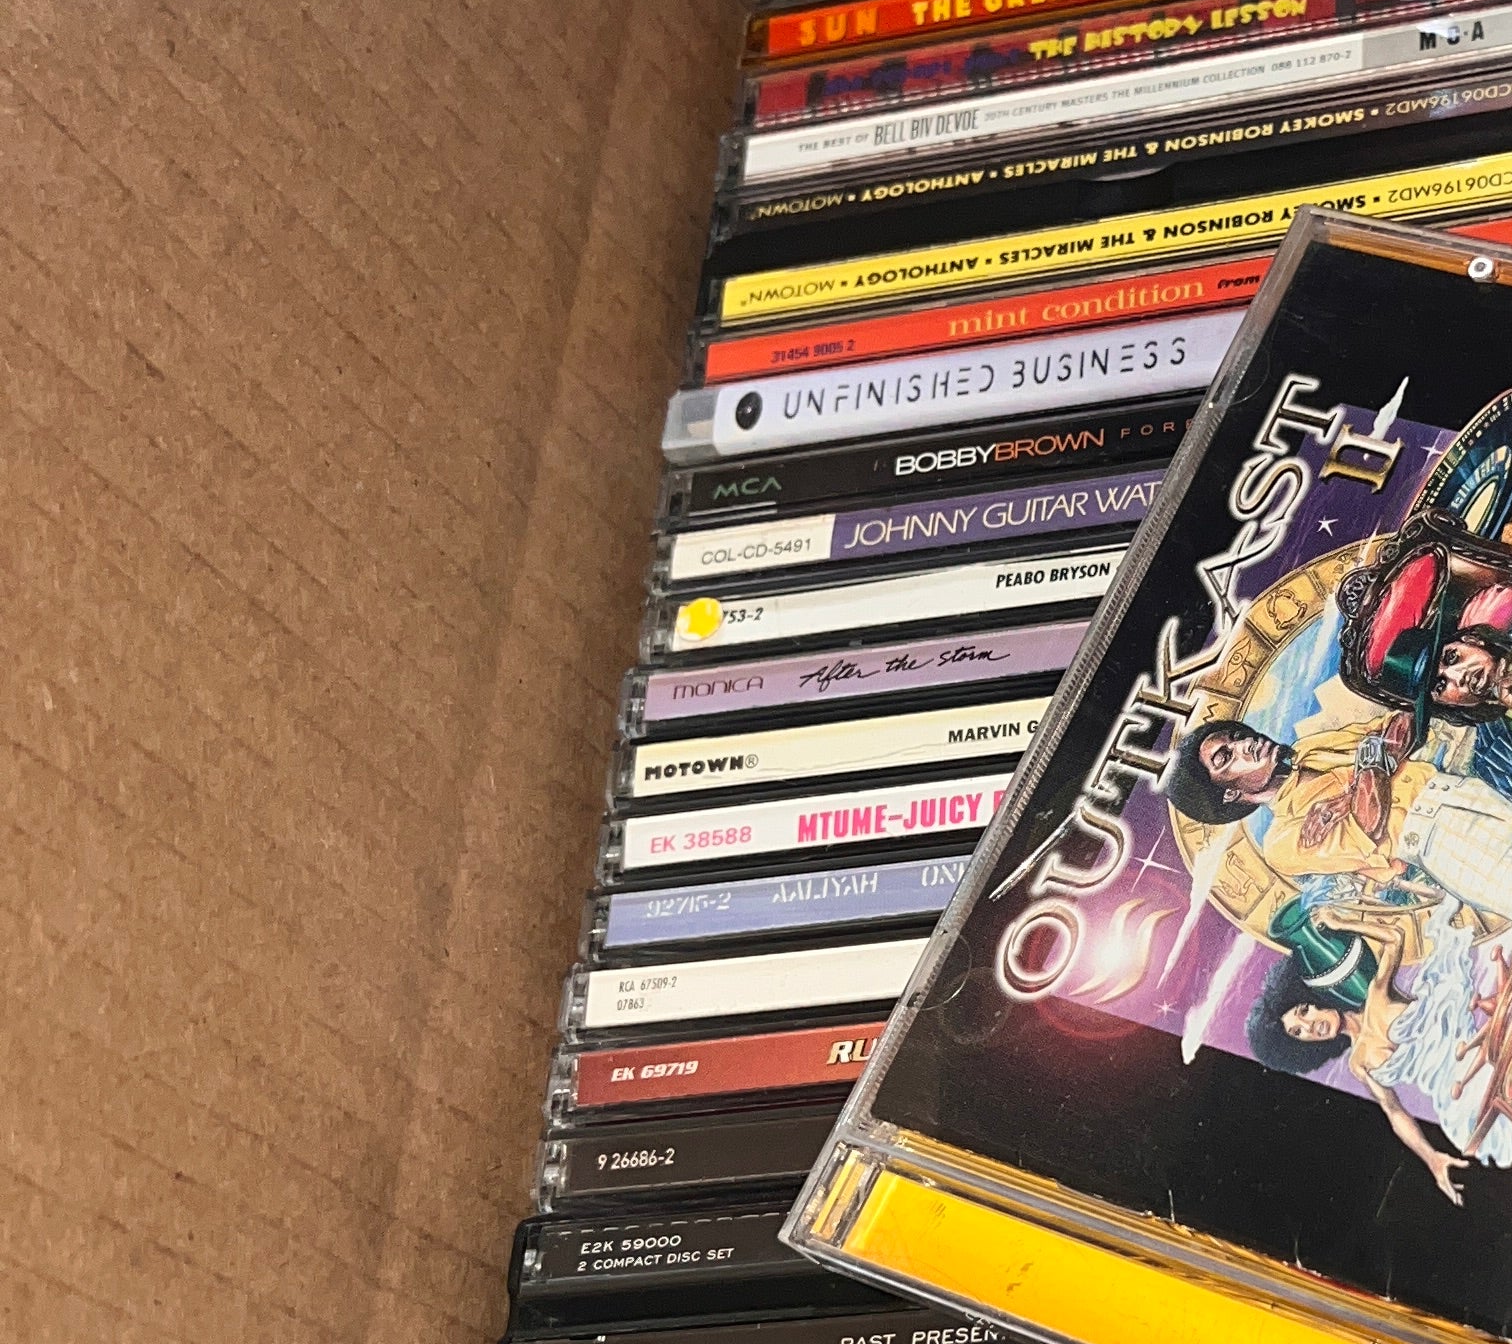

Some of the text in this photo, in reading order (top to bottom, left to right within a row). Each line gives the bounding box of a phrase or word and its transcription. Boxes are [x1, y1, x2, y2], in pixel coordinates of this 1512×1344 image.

[796, 6, 881, 47] SUN
[873, 108, 981, 146] BELL BIV DEVOE
[860, 108, 1365, 203] SMOKEY ROBINSON THE MIRACLES ANTHOLOGY
[1163, 209, 1273, 239] ROBINSON
[999, 237, 1095, 265] MIRACLES
[1101, 231, 1135, 248] THE
[854, 256, 978, 288] ANTHOLOGY
[947, 277, 1206, 337] mint condition
[784, 336, 1188, 420] UNFINISHED BUSINESS
[700, 490, 1088, 567] COL-CD-5491 JOHNNY GUITAR
[995, 562, 1111, 590] PEABO BRYSON
[885, 654, 936, 674] the
[998, 372, 1345, 1000] OUTKAST
[948, 722, 1022, 744] MARVIN
[650, 826, 753, 855] EK 38588
[772, 870, 880, 905] AALIYAH
[619, 975, 678, 994] RCA 67509-2
[610, 1059, 699, 1082] EK 69719
[596, 1147, 676, 1172] 9 26686-2
[580, 1233, 682, 1256] E2K 59000
[576, 1247, 735, 1273] 2 COMPACT DISC SET
